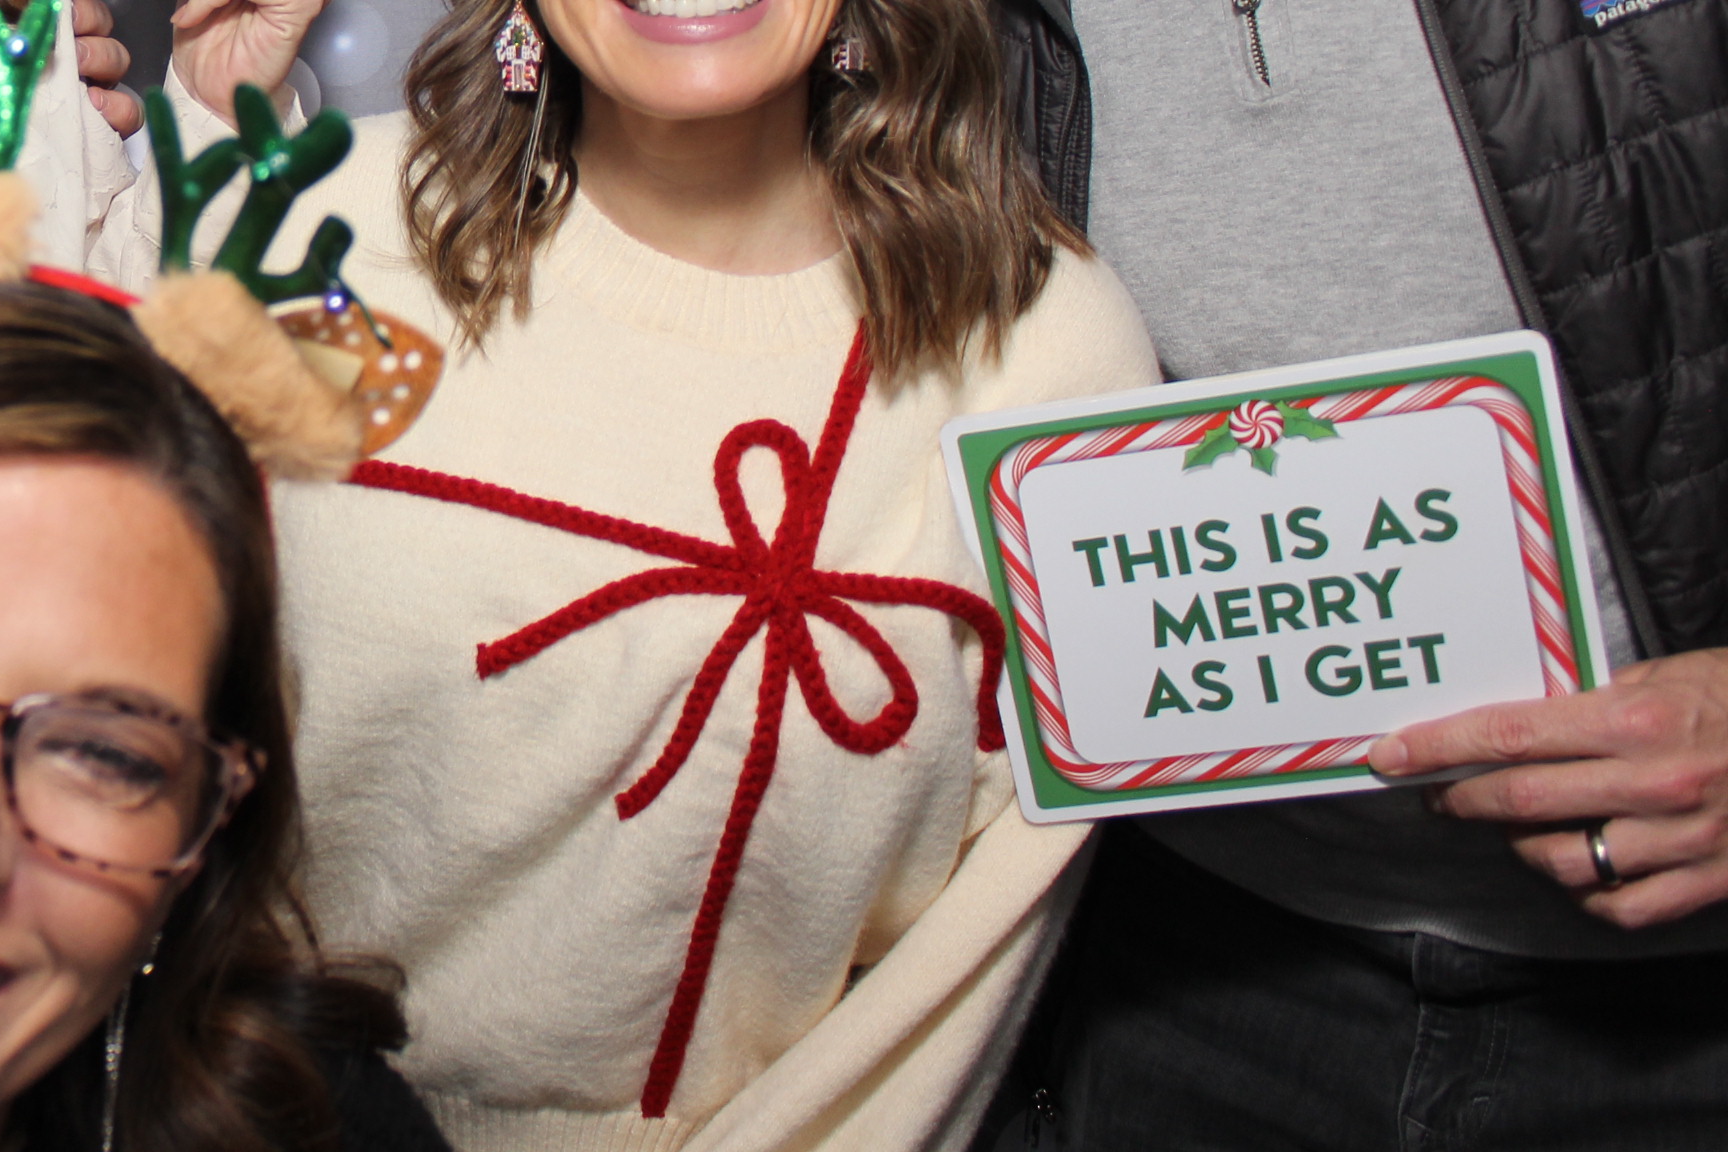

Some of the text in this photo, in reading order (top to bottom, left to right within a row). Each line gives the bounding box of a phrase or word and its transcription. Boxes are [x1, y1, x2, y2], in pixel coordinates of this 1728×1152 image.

[1072, 488, 1459, 587] THIS IS AS
[1152, 567, 1403, 648] MERRY
[1143, 633, 1446, 719] AS I GET
